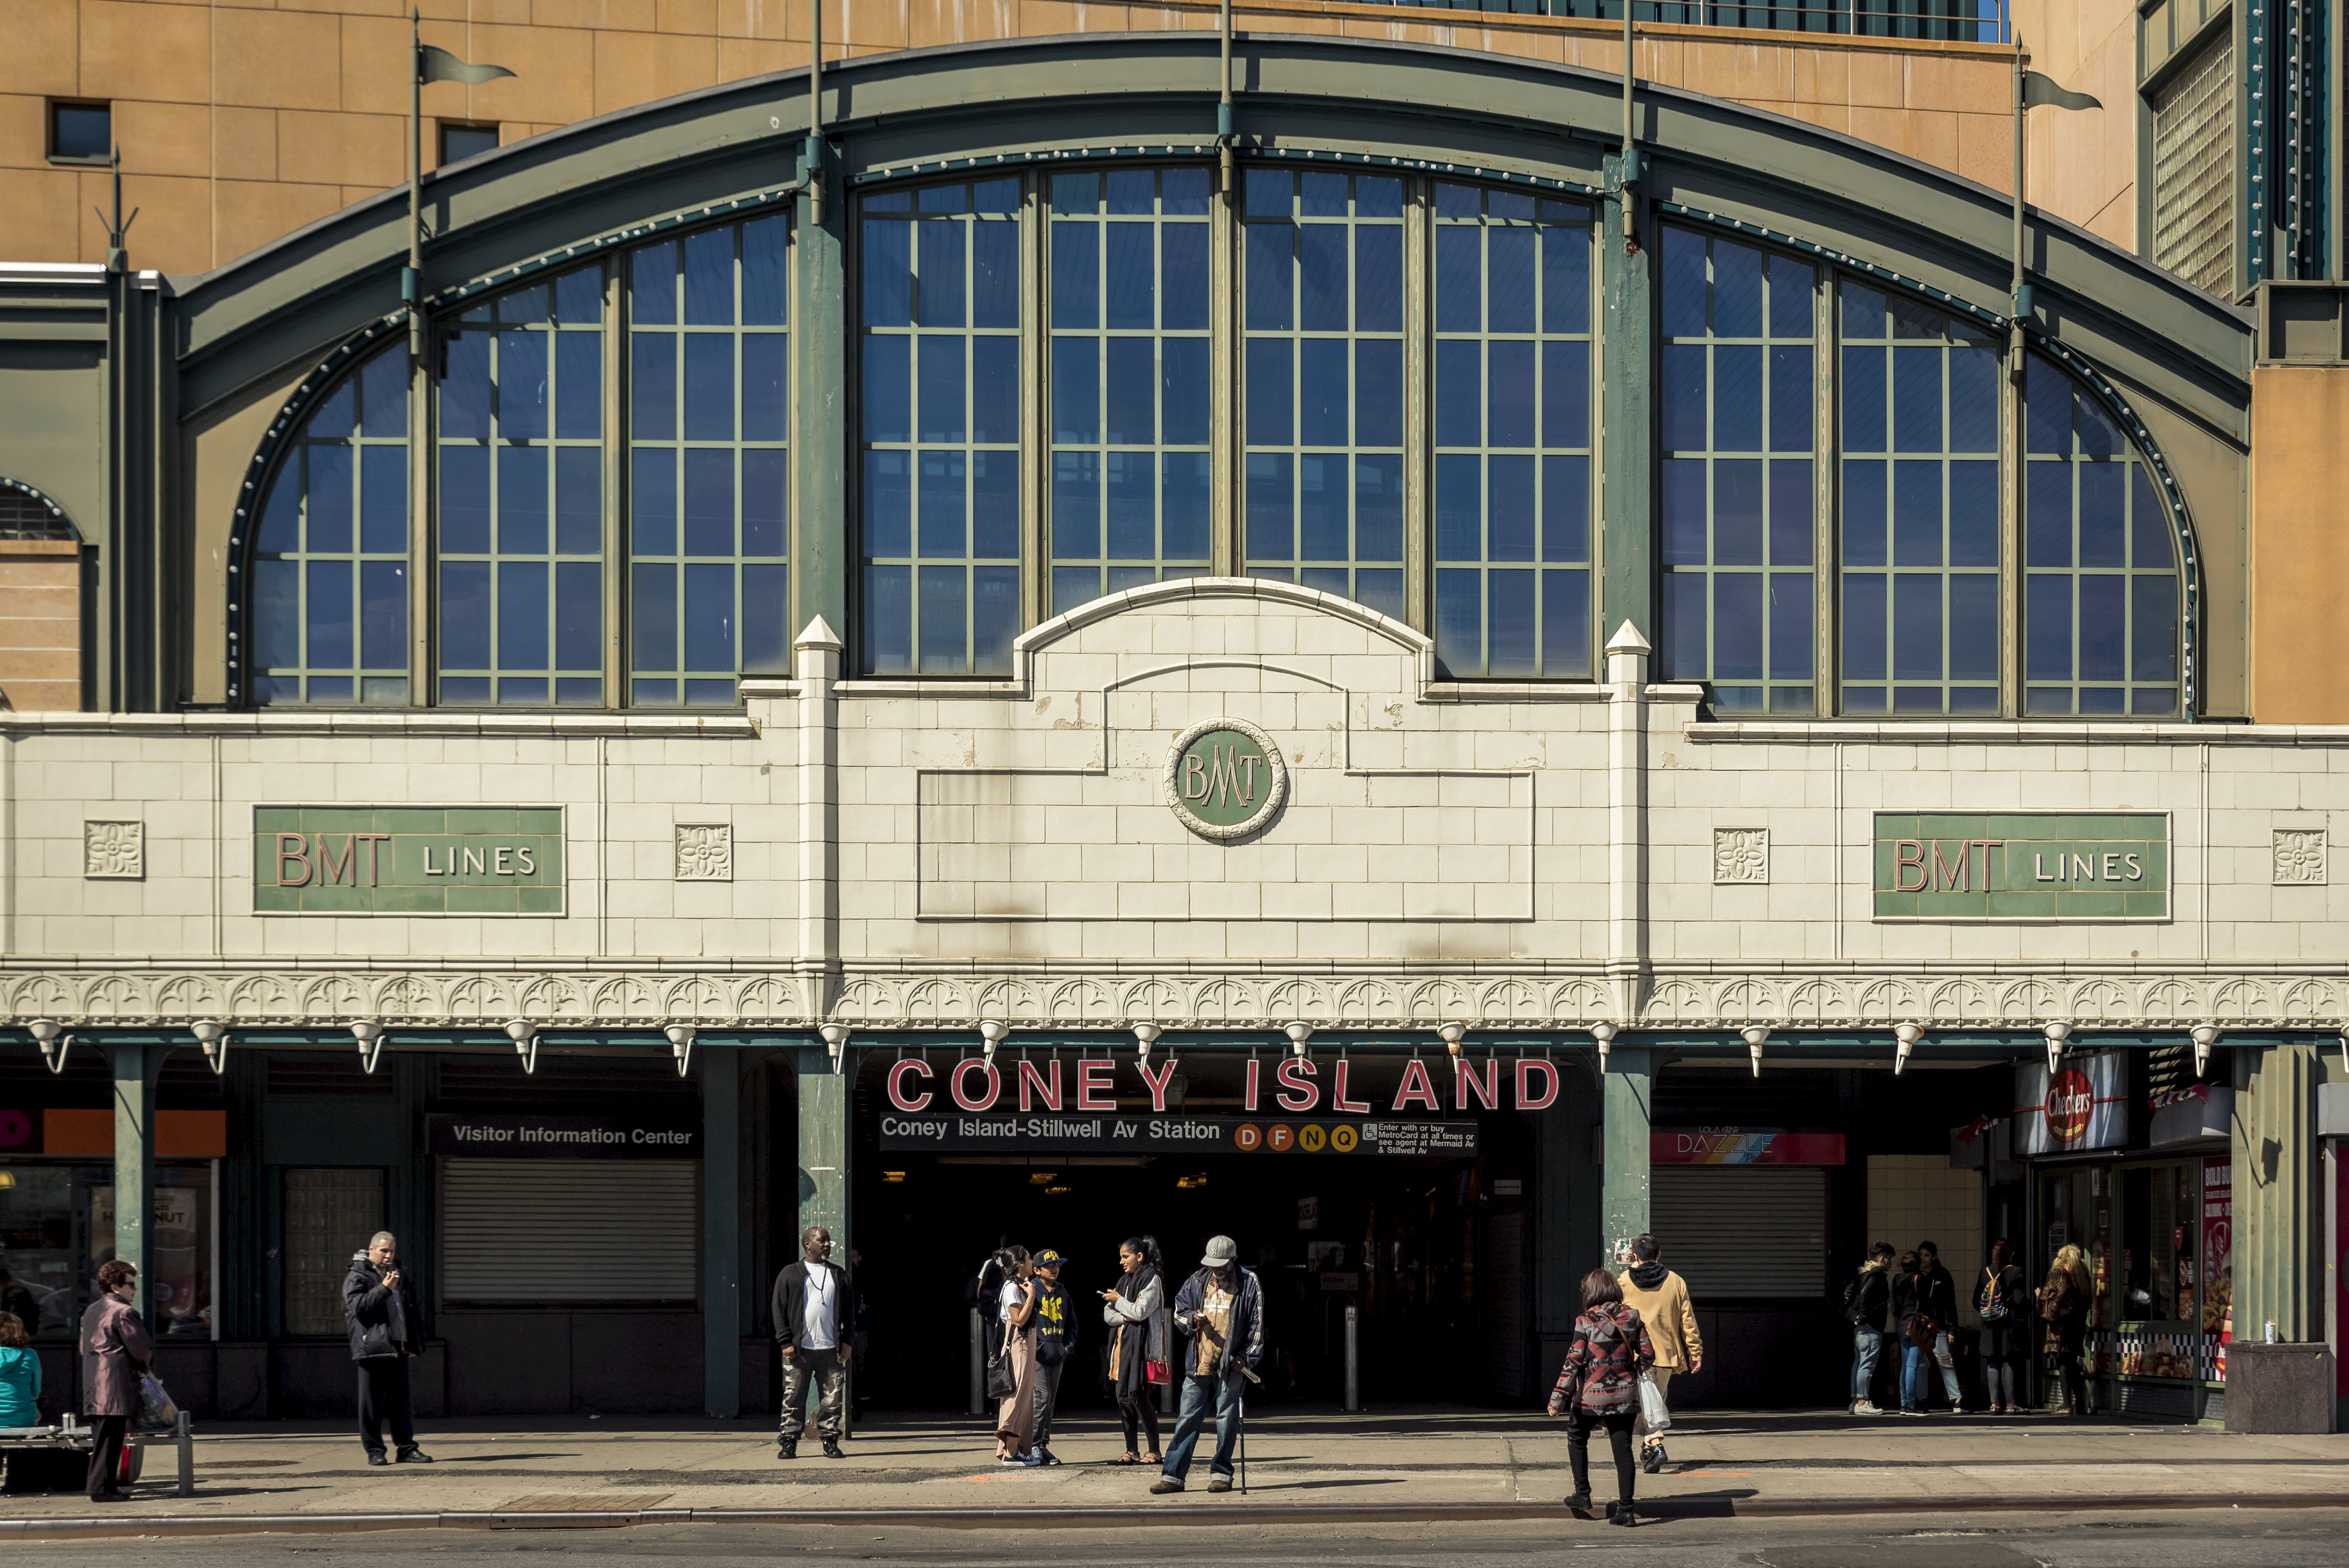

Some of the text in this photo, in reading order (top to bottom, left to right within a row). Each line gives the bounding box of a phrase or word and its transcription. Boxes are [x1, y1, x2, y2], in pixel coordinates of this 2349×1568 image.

[1185, 745, 1262, 807] BMT
[277, 833, 536, 887] BMT LINES
[1895, 840, 2142, 893] BMT LINES
[887, 1058, 1560, 1113] CONEY ISLAND
[2048, 1085, 2090, 1117] Checkers
[453, 1125, 693, 1144] Visitor Information Center
[881, 1118, 1220, 1140] Coney Island-Stillwell Av Station
[1242, 1130, 1351, 1146] D F N Q
[1430, 1125, 1445, 1133] buy
[2064, 1128, 2073, 1137] GOOD
[2073, 1123, 2081, 1134] FOOD
[1678, 1134, 1773, 1153] DAZZLE
[2205, 1167, 2221, 1186] BOLD
